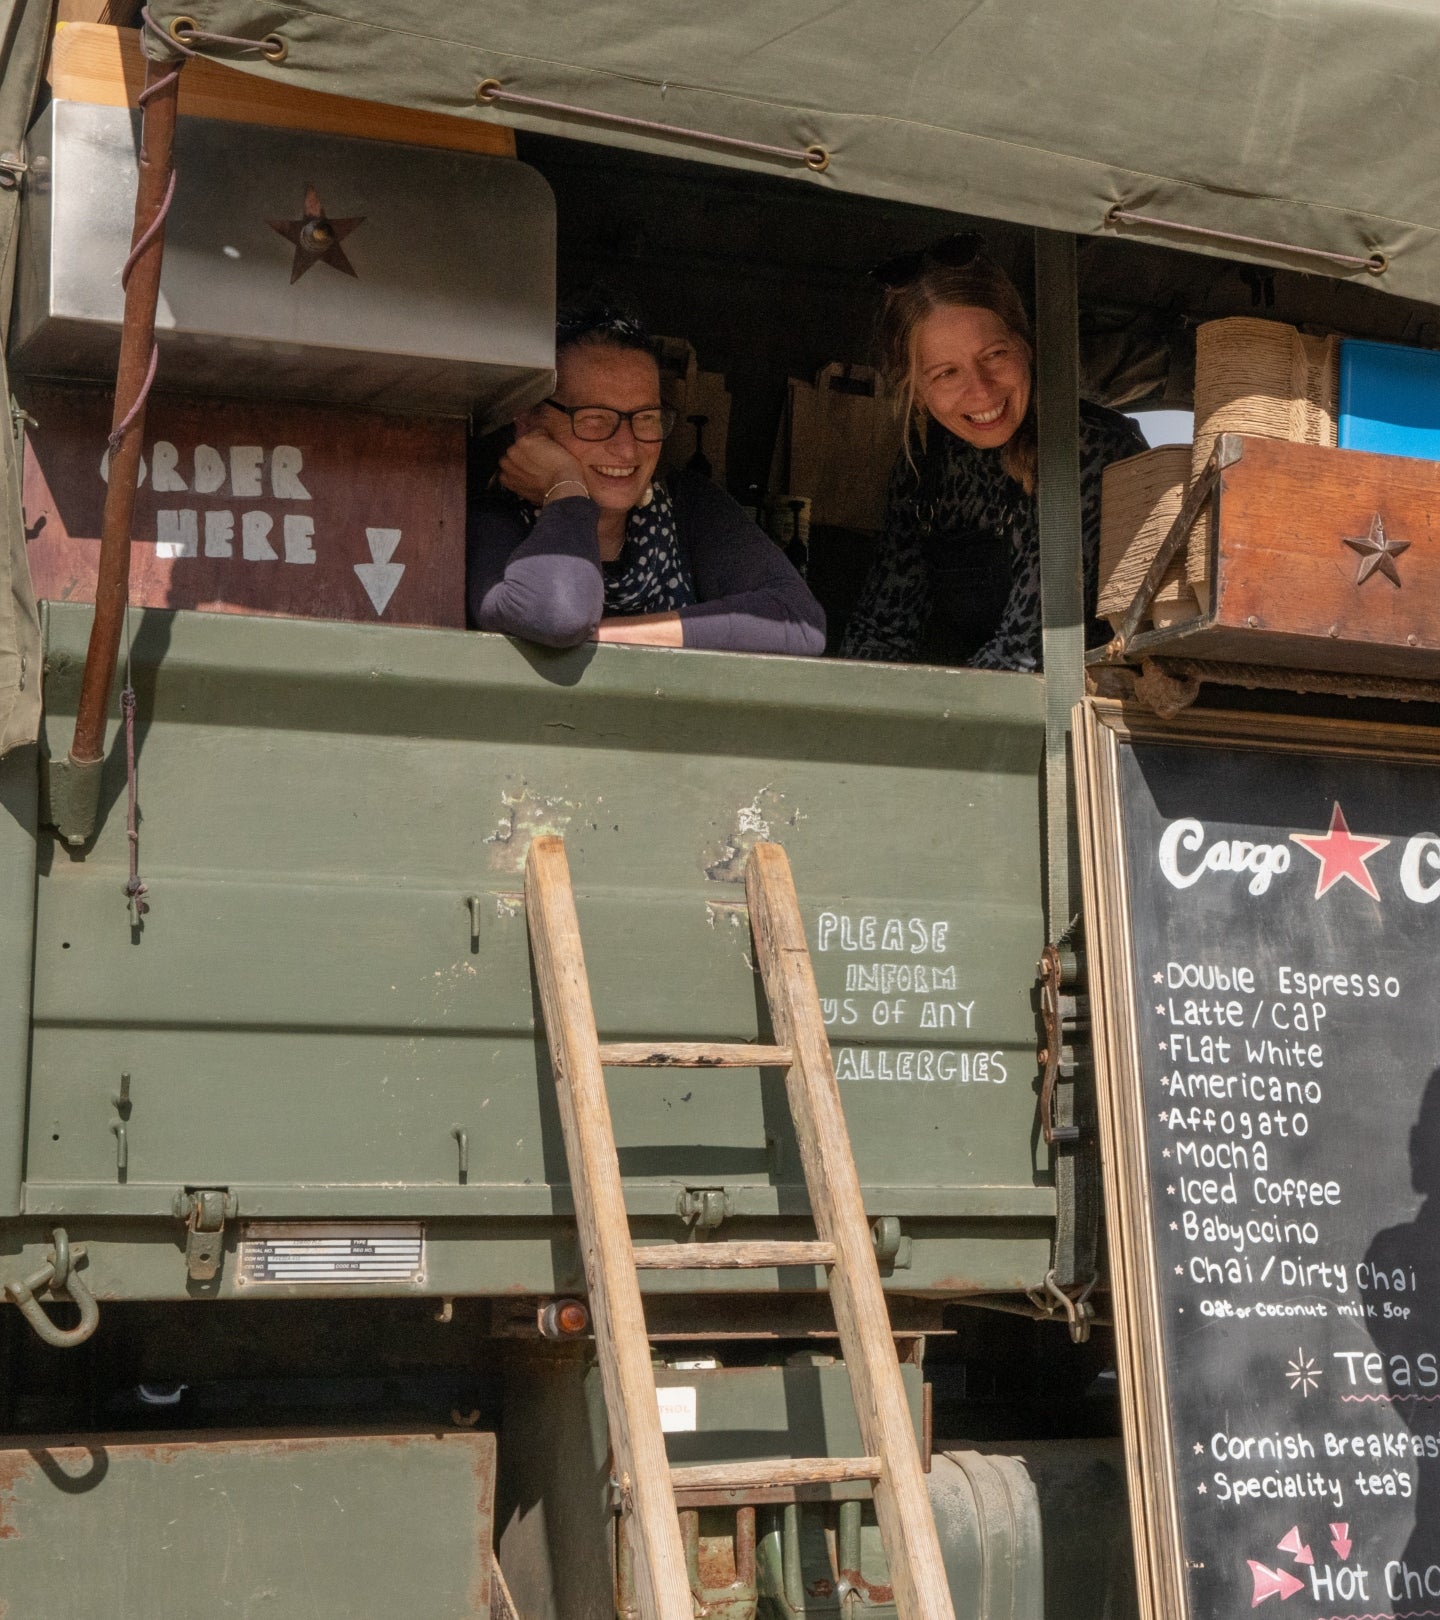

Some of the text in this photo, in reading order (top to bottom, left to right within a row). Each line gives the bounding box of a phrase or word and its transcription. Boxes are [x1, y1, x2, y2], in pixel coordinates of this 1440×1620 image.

[155, 509, 316, 564] HERE
[1159, 817, 1290, 896] Cargo
[818, 912, 949, 954] PLEASE
[845, 963, 957, 994] INFORM
[1278, 966, 1400, 1000] Espresso
[835, 1048, 1008, 1084] ALLERGIES
[1169, 1070, 1322, 1105] Americano
[1168, 1106, 1309, 1140] Affogato
[1176, 1140, 1268, 1172] Mocha
[1180, 1172, 1342, 1209] Iced Coffee
[1182, 1210, 1319, 1253] Babyccino
[1355, 1261, 1417, 1292] Chai
[1200, 1300, 1235, 1318] Oat
[1336, 1300, 1378, 1318] milk
[1382, 1301, 1411, 1321] 50p
[1333, 1350, 1439, 1387] Teas
[1210, 1432, 1315, 1462] Cornish
[1213, 1468, 1412, 1508] Speciality tea's
